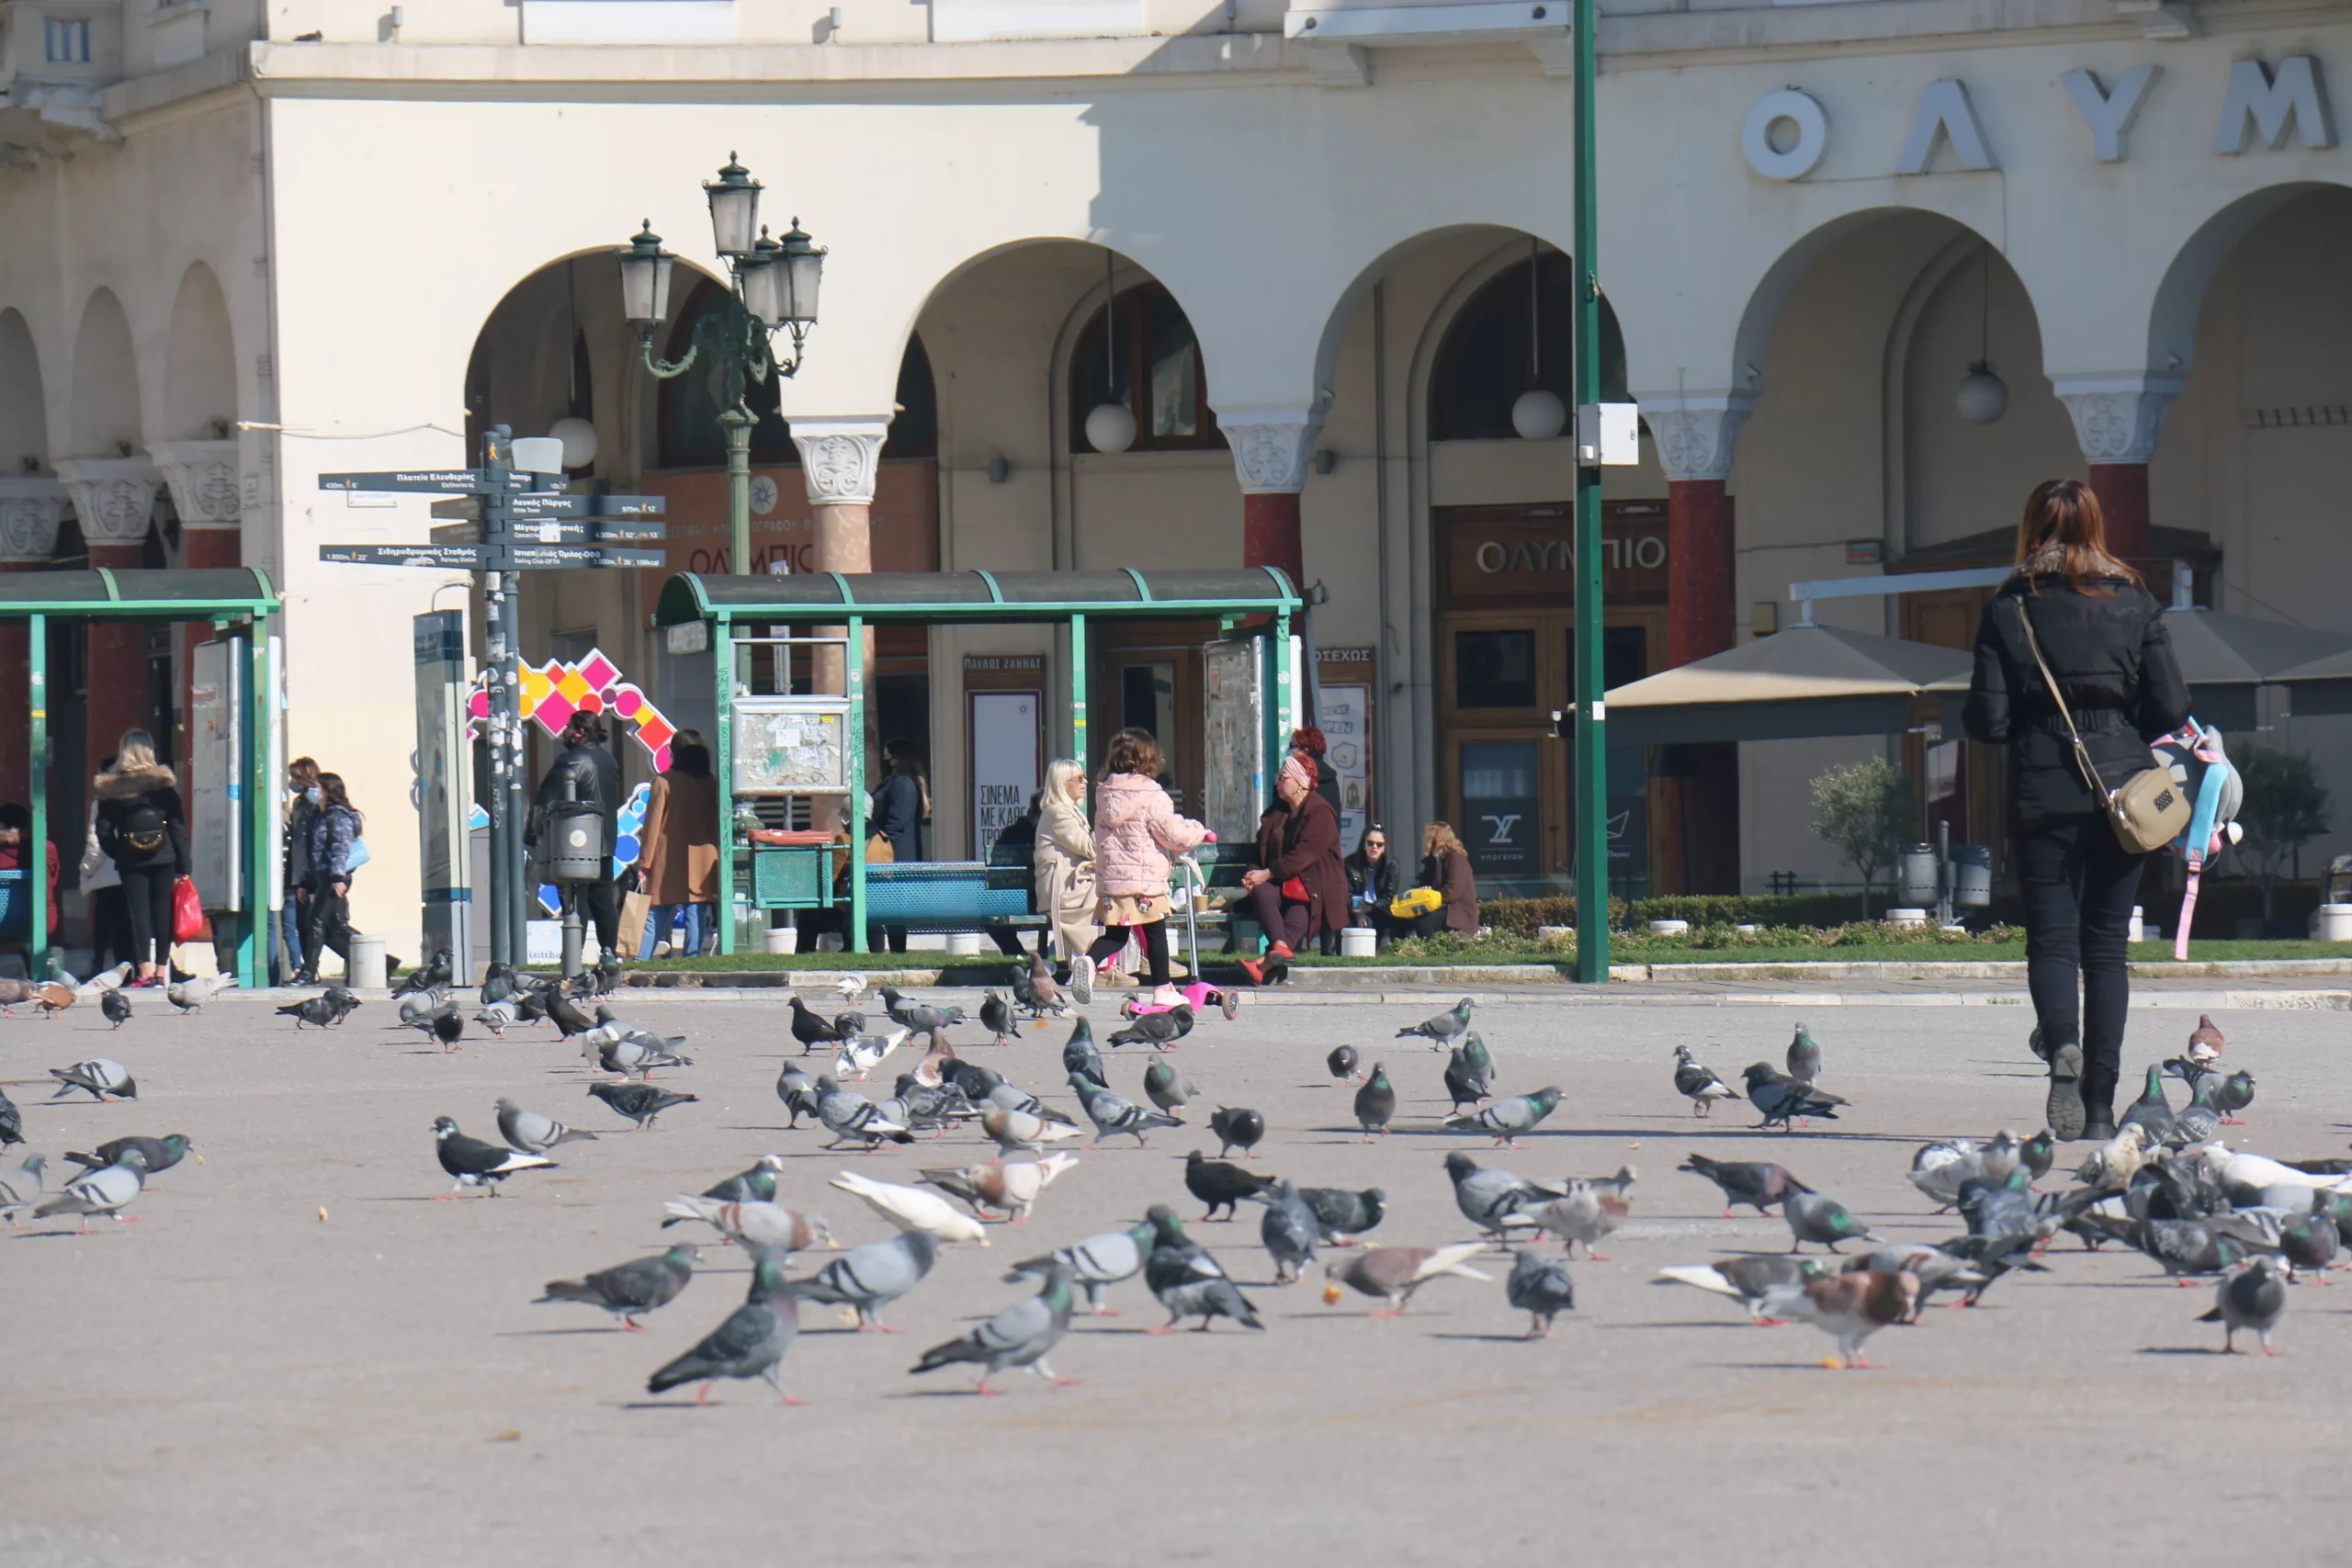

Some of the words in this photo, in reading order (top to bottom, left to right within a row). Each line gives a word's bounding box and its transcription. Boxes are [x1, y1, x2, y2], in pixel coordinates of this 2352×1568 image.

[396, 473, 429, 481] Πλατεία
[429, 472, 475, 482] Ελευθερίας
[513, 498, 540, 508] Λευκός
[542, 499, 571, 508] Πύργος
[378, 547, 442, 557] Σιδηροδρομικός
[443, 547, 477, 557] Σταθμός
[440, 556, 459, 564] Railway
[965, 658, 1001, 670] ΠΑΥΛΟΣ
[980, 784, 1020, 805] ΣΙΝΕΜΑ
[980, 807, 996, 827] ΜΕ
